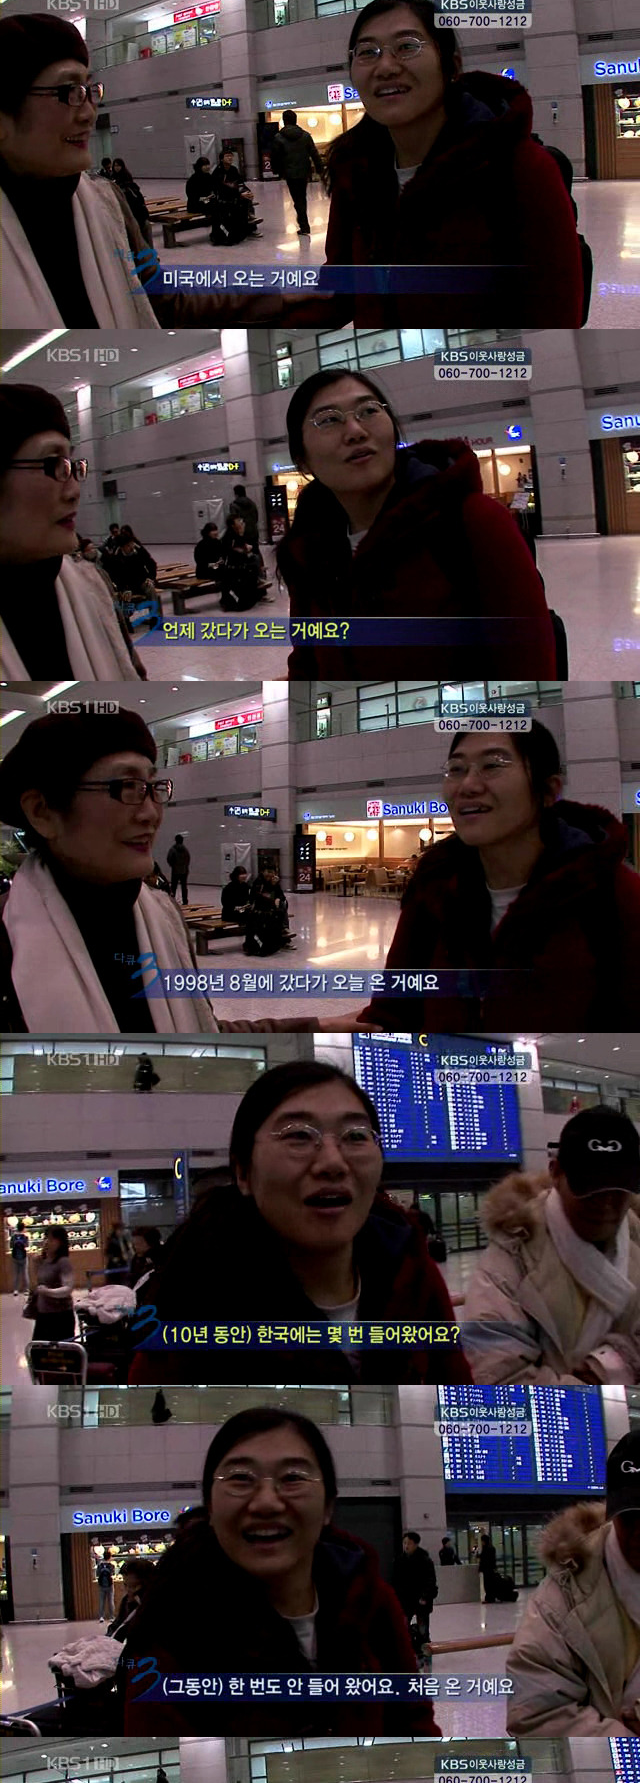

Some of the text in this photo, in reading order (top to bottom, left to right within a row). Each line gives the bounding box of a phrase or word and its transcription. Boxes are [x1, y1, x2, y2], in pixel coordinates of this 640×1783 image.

[383, 801, 426, 815] Sanuki
[419, 1033, 428, 1047] C
[174, 1157, 182, 1179] C
[0, 1178, 85, 1195] anuki Bore
[73, 1508, 170, 1526] Sanuki Bore
